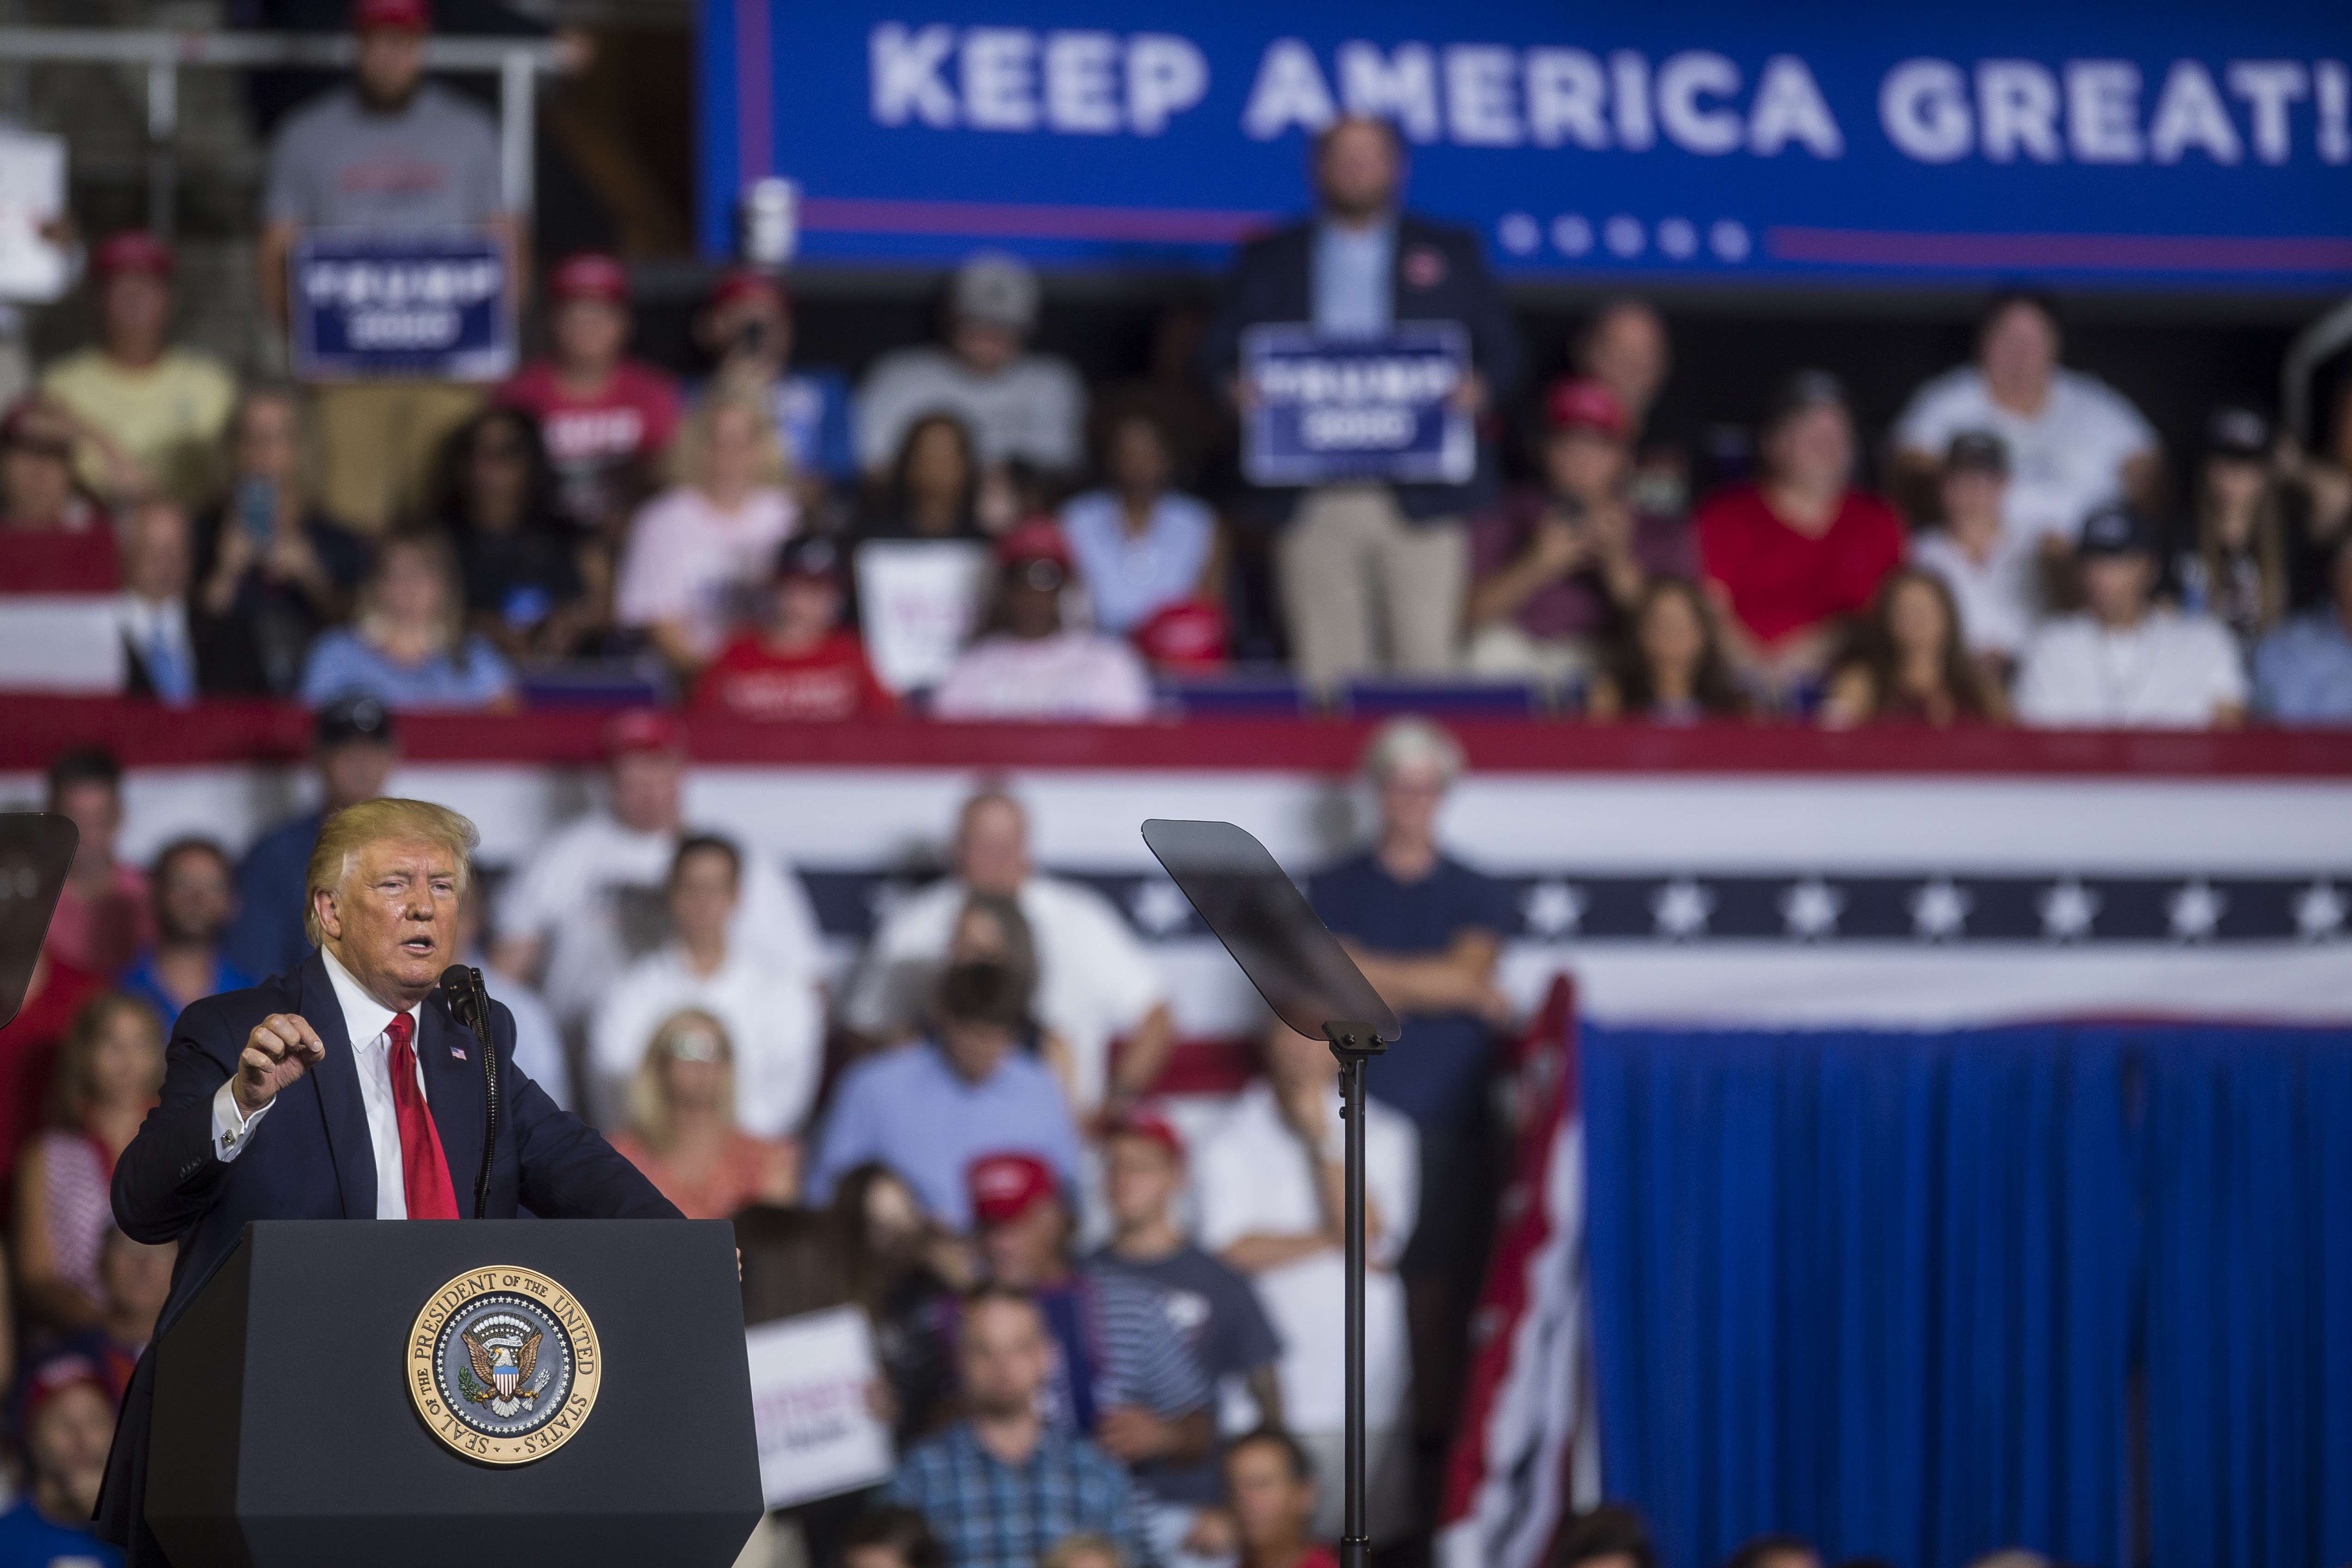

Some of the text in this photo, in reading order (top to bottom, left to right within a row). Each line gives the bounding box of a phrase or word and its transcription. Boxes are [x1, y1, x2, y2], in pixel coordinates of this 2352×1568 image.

[870, 22, 2352, 167] KEEP AMERICA GREAT!
[414, 1273, 595, 1454] SEAL OF THE PRESIDENT OF THE UNITED STATES
